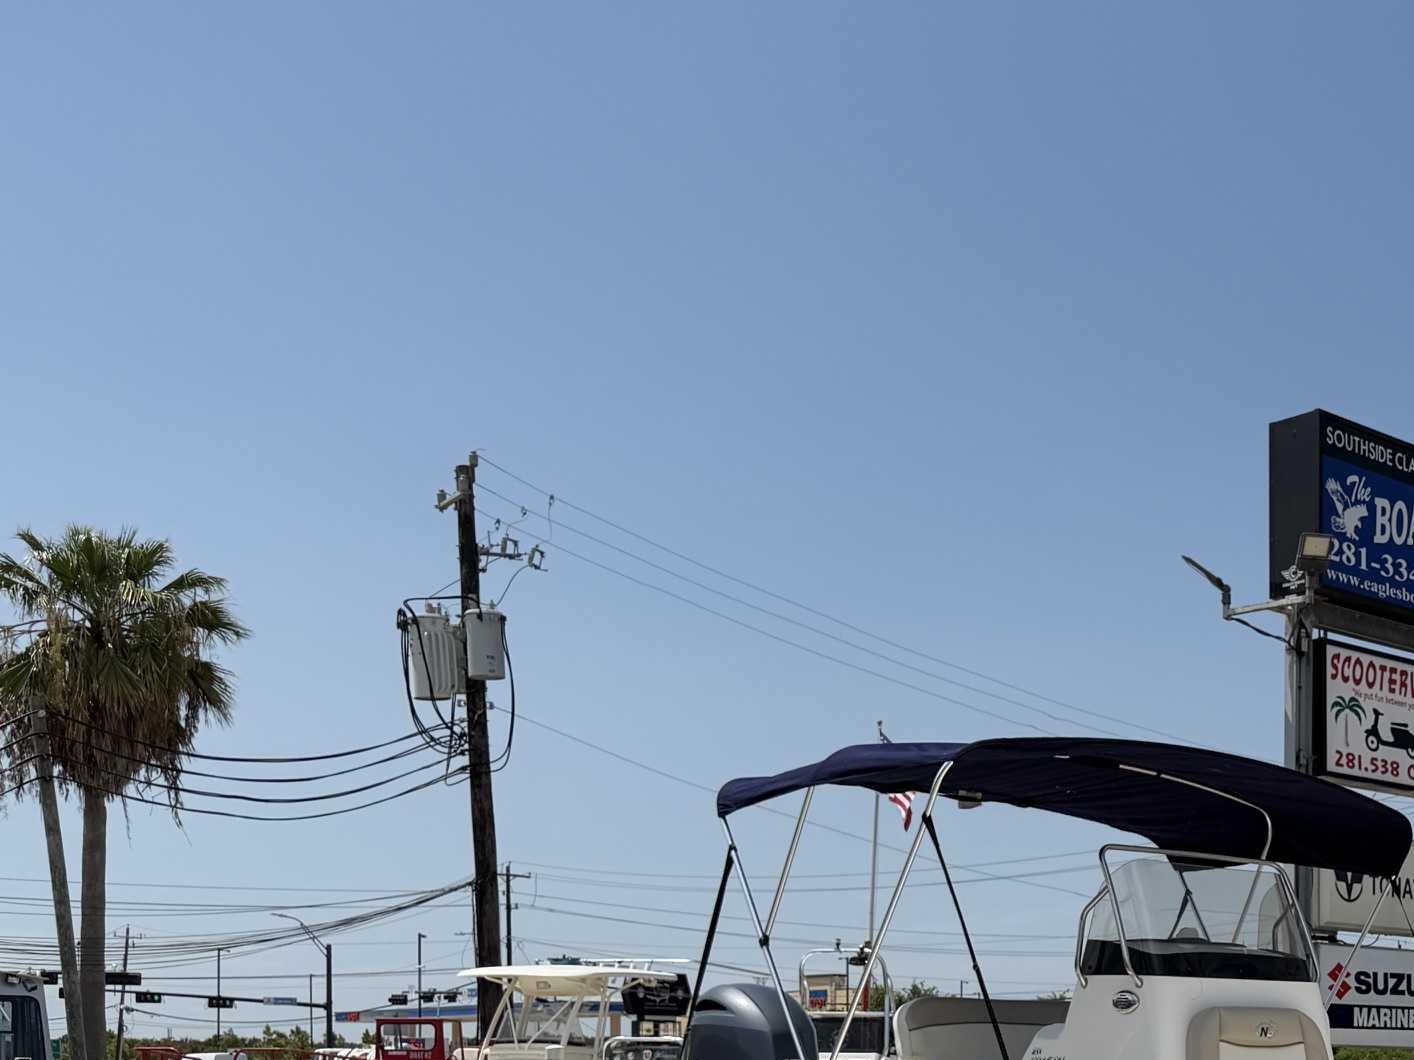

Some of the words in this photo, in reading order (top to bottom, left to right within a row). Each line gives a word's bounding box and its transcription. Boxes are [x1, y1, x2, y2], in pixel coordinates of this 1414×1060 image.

[1326, 426, 1393, 466] SOUTHSIDE
[1346, 475, 1372, 503] The
[1335, 750, 1400, 777] 281.538
